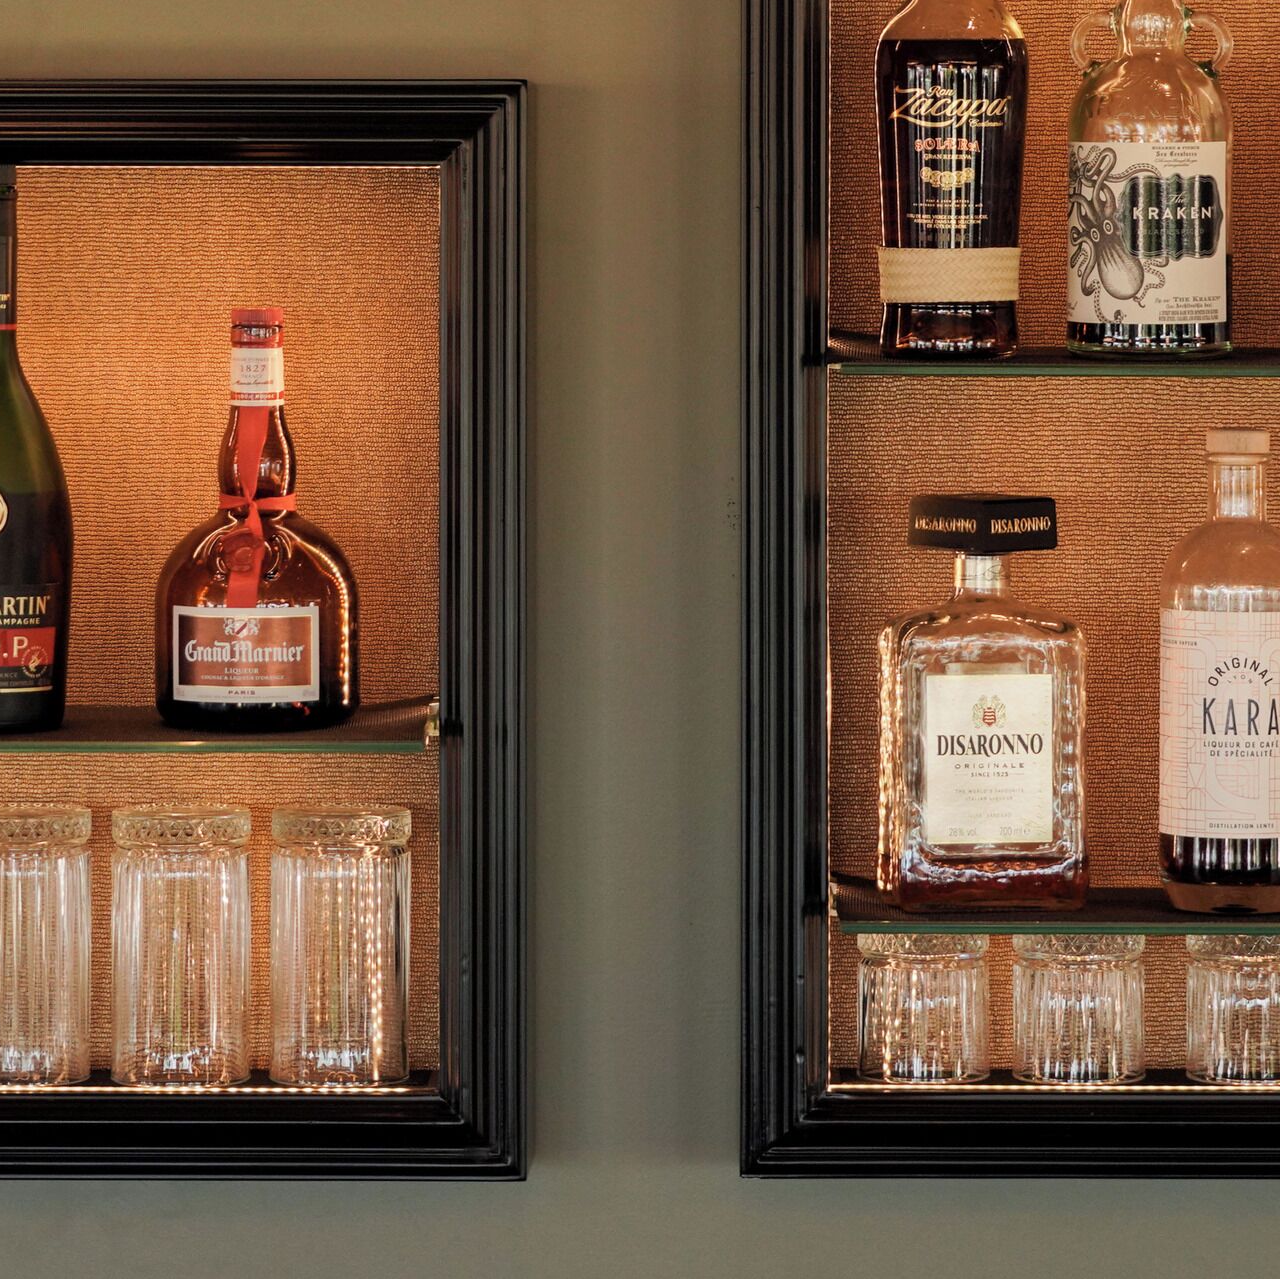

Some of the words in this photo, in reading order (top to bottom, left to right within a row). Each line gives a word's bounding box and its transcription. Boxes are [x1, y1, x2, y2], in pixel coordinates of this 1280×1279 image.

[926, 85, 955, 98] Ron
[889, 85, 1012, 128] Zacapa
[914, 137, 981, 153] SOLERA
[1168, 191, 1187, 204] The
[1132, 206, 1212, 220] KRAKEN
[241, 364, 267, 373] 1827
[914, 515, 977, 534] DISARONNO
[990, 516, 1051, 535] DISARONNO
[185, 640, 231, 663] Grand
[230, 640, 305, 663] Marnier
[224, 667, 259, 675] LIQUEUR
[1206, 656, 1275, 687] ORIGINAL
[1202, 697, 1280, 736] KARA
[936, 733, 1044, 758] DISARONNO
[1203, 740, 1241, 749] LIQUEUR
[1245, 740, 1257, 749] DE
[1259, 739, 1280, 749] CAFÉ
[1209, 750, 1221, 758] DE
[1225, 748, 1274, 758] SPÉCIALITÉ
[954, 762, 1025, 770] ORIGINALE
[1209, 822, 1254, 830] DISTILLATION
[1256, 822, 1275, 830] LENTE
